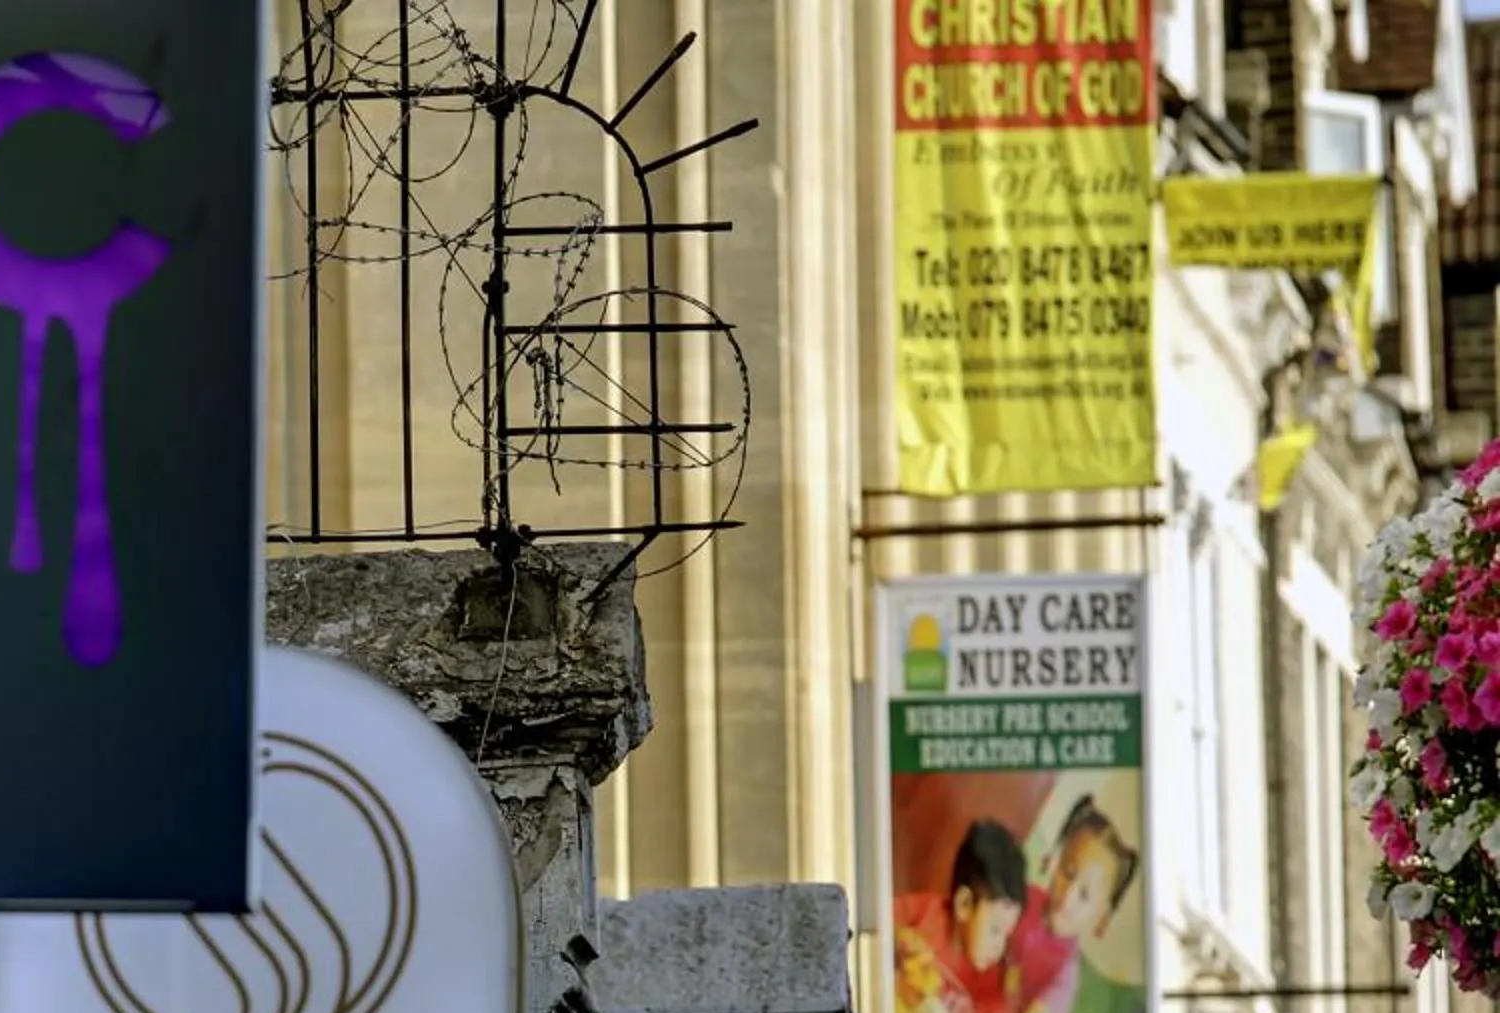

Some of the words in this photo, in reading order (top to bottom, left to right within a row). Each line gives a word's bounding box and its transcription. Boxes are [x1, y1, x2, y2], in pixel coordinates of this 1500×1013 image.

[909, 0, 1138, 47] CHRISTIAN
[904, 63, 1028, 119] CHURCH
[1033, 61, 1074, 117] OF
[1080, 59, 1143, 117] GOD
[956, 594, 1027, 634] DAY
[1039, 592, 1138, 633] CARE
[958, 646, 1138, 688] NURSERY
